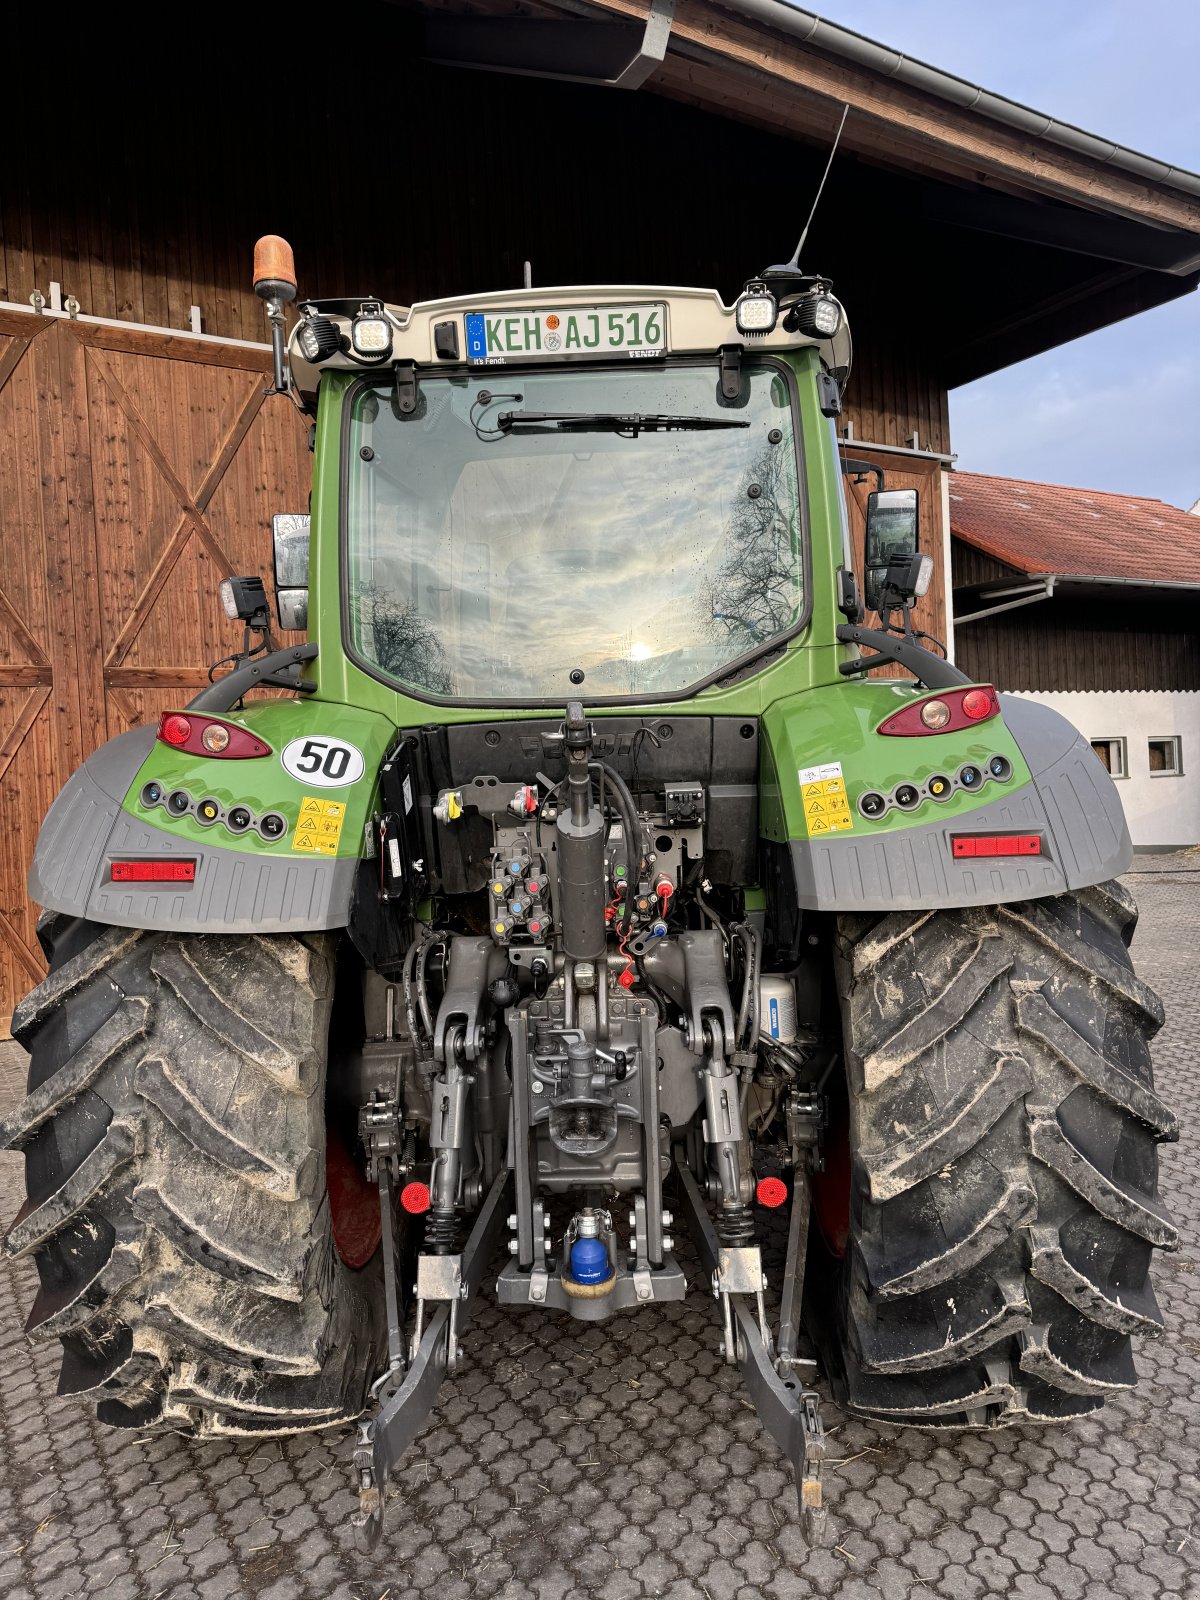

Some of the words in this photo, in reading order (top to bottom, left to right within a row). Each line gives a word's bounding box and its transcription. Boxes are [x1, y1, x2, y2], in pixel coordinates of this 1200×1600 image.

[473, 341, 481, 351] D
[485, 317, 542, 352] KEH
[565, 314, 600, 348] AJ
[607, 311, 661, 346] 516
[473, 357, 484, 365] It's
[628, 349, 662, 358] FENDT
[296, 740, 352, 779] 50
